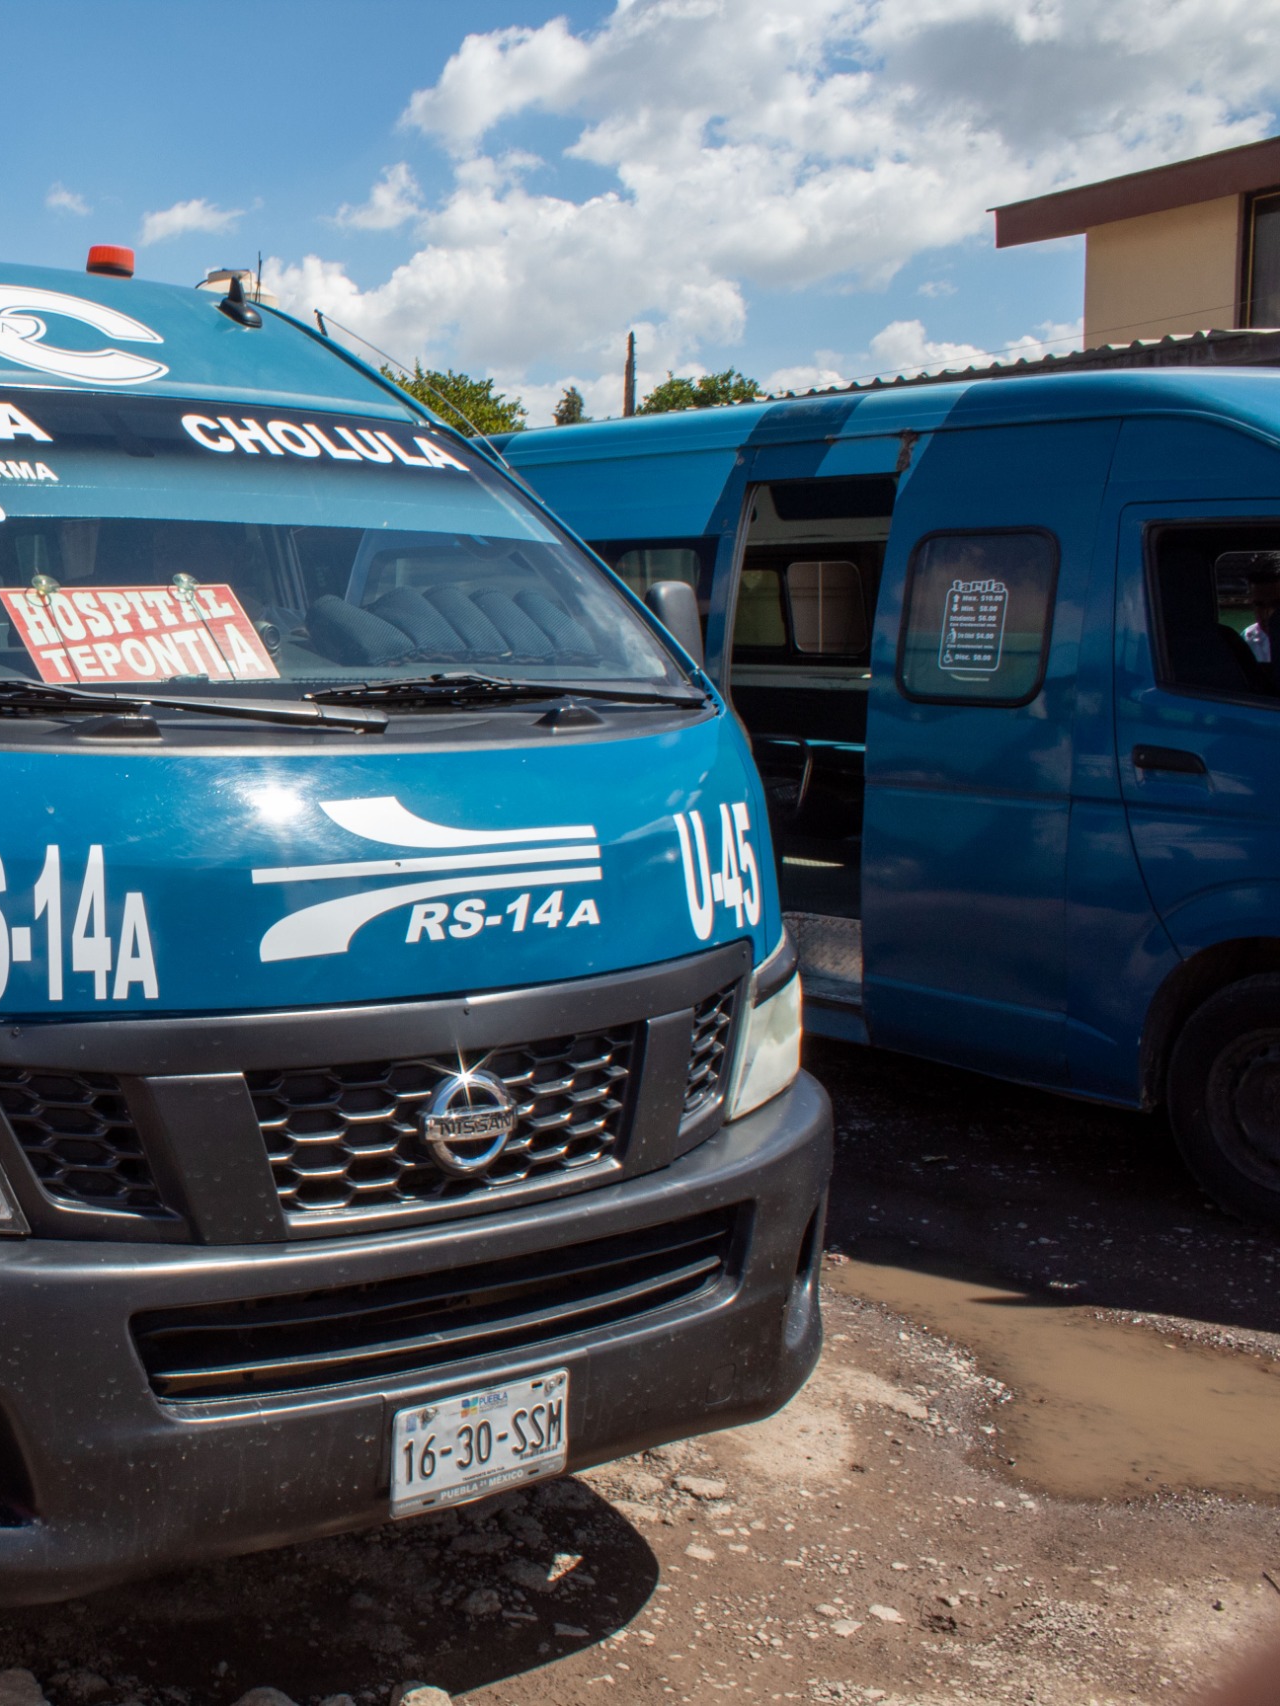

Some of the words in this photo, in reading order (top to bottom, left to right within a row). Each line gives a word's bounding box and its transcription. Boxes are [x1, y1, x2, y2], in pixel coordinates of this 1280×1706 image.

[181, 414, 471, 472] CHOLULA
[953, 579, 1005, 593] tarifa
[8, 588, 236, 647] HOSPITAL
[40, 623, 267, 678] TEPONTLA
[672, 801, 762, 941] U-45
[405, 890, 601, 943] RS-14A
[440, 1113, 512, 1136] NISSAN
[478, 1391, 509, 1406] PUEBLA
[404, 1396, 563, 1486] 16-30-SSM
[440, 1481, 479, 1500] PUEBLA
[488, 1469, 525, 1487] MÉXICO
